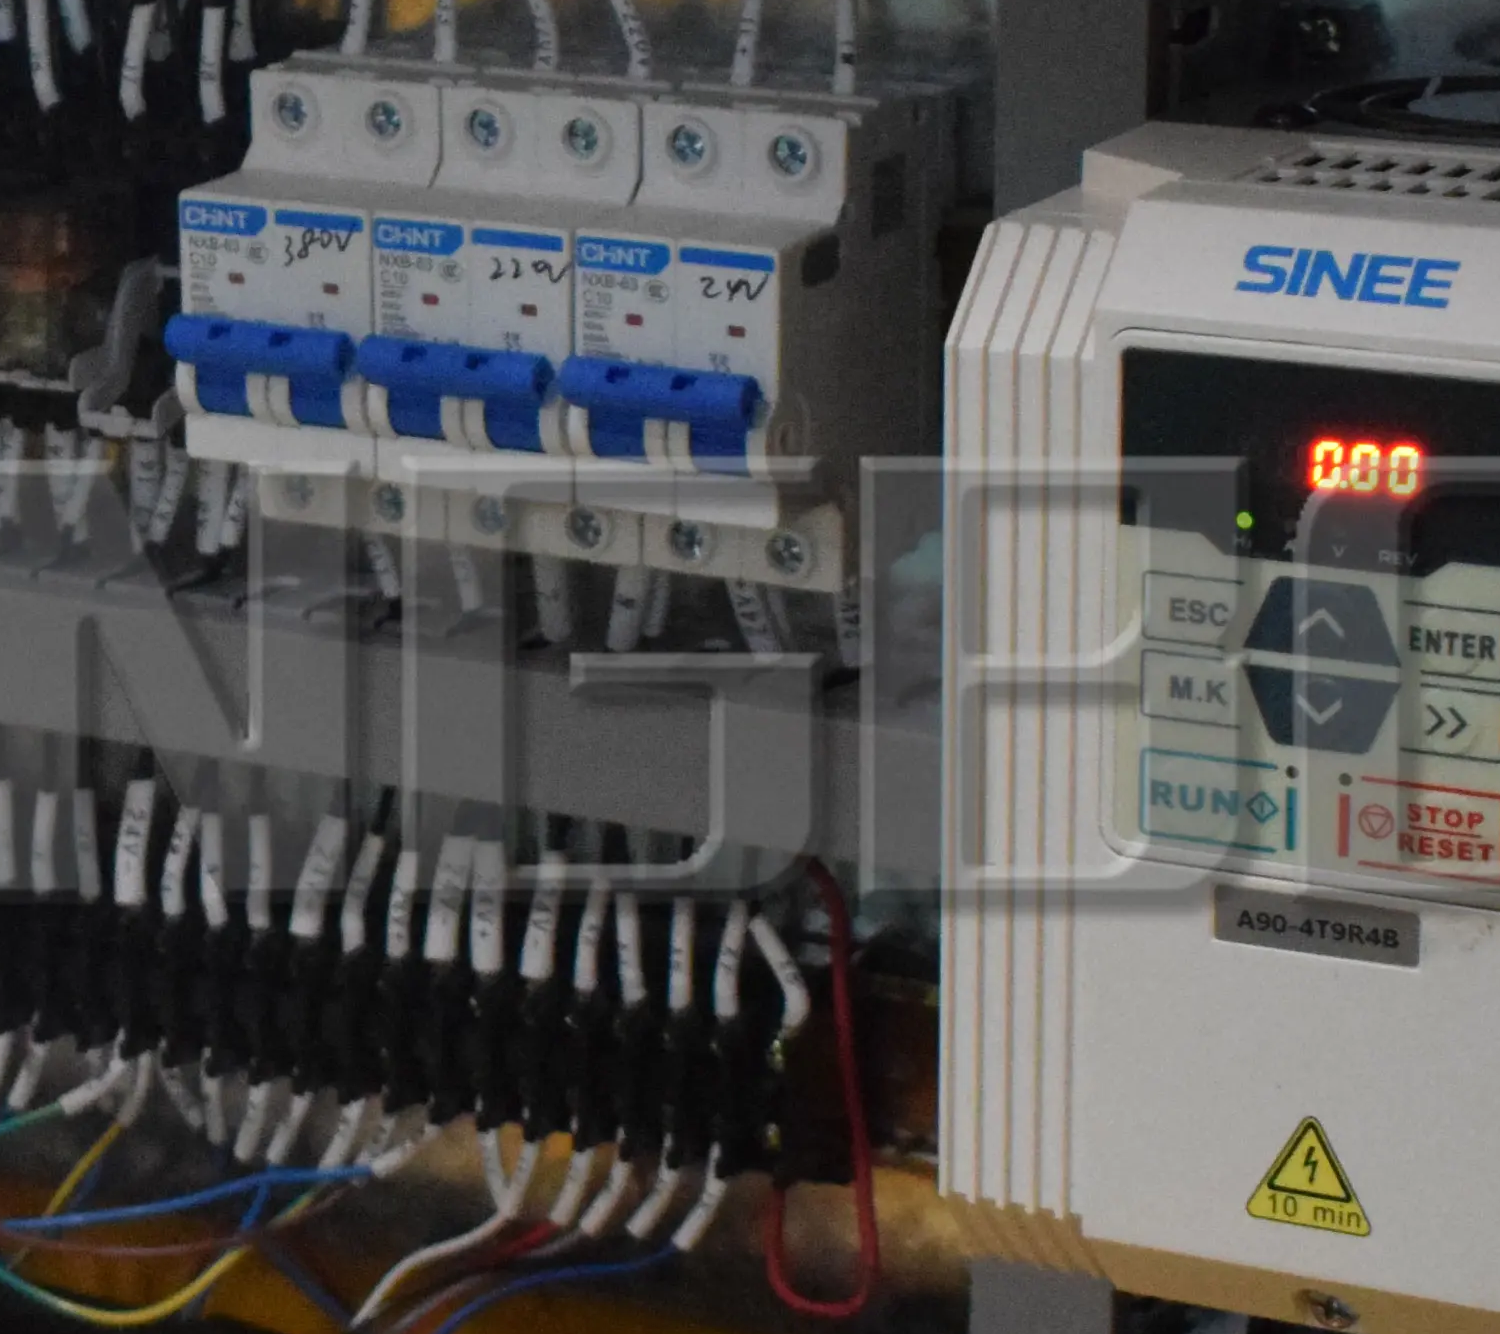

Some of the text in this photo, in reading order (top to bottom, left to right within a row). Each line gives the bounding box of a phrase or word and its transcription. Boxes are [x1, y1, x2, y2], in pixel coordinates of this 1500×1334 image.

[284, 224, 357, 267] 380V
[699, 274, 768, 303] 24V
[1235, 244, 1461, 308] SINEE
[1308, 439, 1421, 496] 0.00
[1378, 548, 1419, 566] REV
[1169, 597, 1230, 628] ESC
[1408, 626, 1496, 661] ENTER
[1169, 675, 1227, 706] M.K
[1150, 779, 1240, 815] RUN
[1406, 803, 1485, 830] STOP
[1398, 832, 1495, 863] RESET
[1237, 908, 1400, 950] A90-4T9R4B
[1266, 1192, 1362, 1229] 10 min
